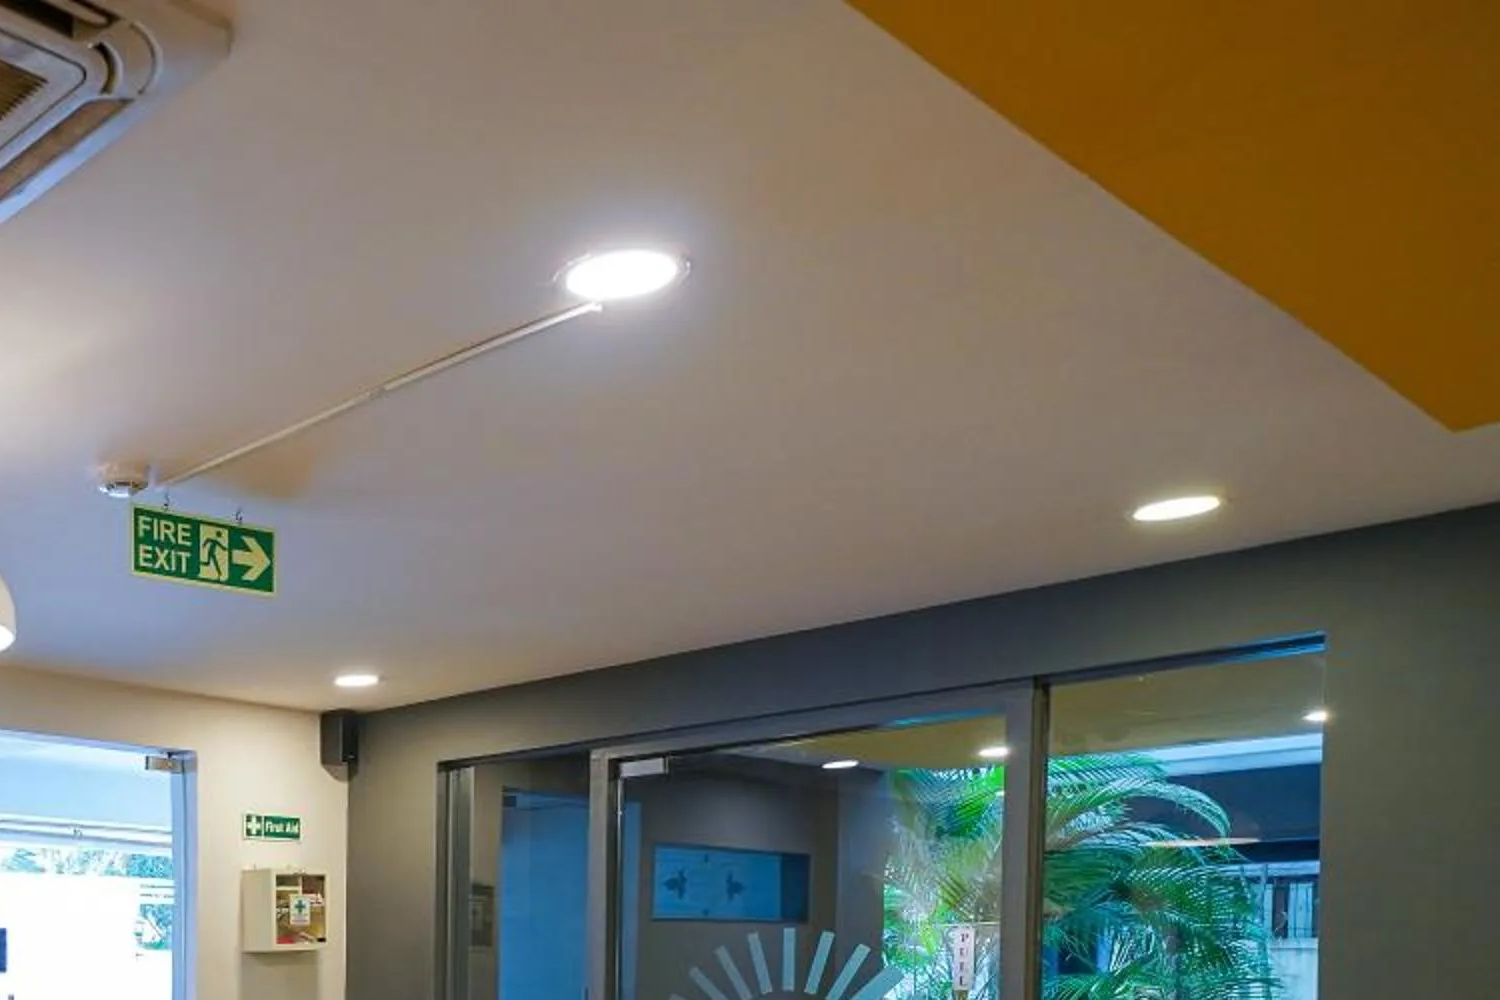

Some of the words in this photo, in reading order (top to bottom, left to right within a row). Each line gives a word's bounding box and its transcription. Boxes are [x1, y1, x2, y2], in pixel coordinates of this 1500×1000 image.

[138, 515, 192, 546] FIRE
[139, 543, 191, 574] EXIT
[959, 932, 970, 987] PULL
